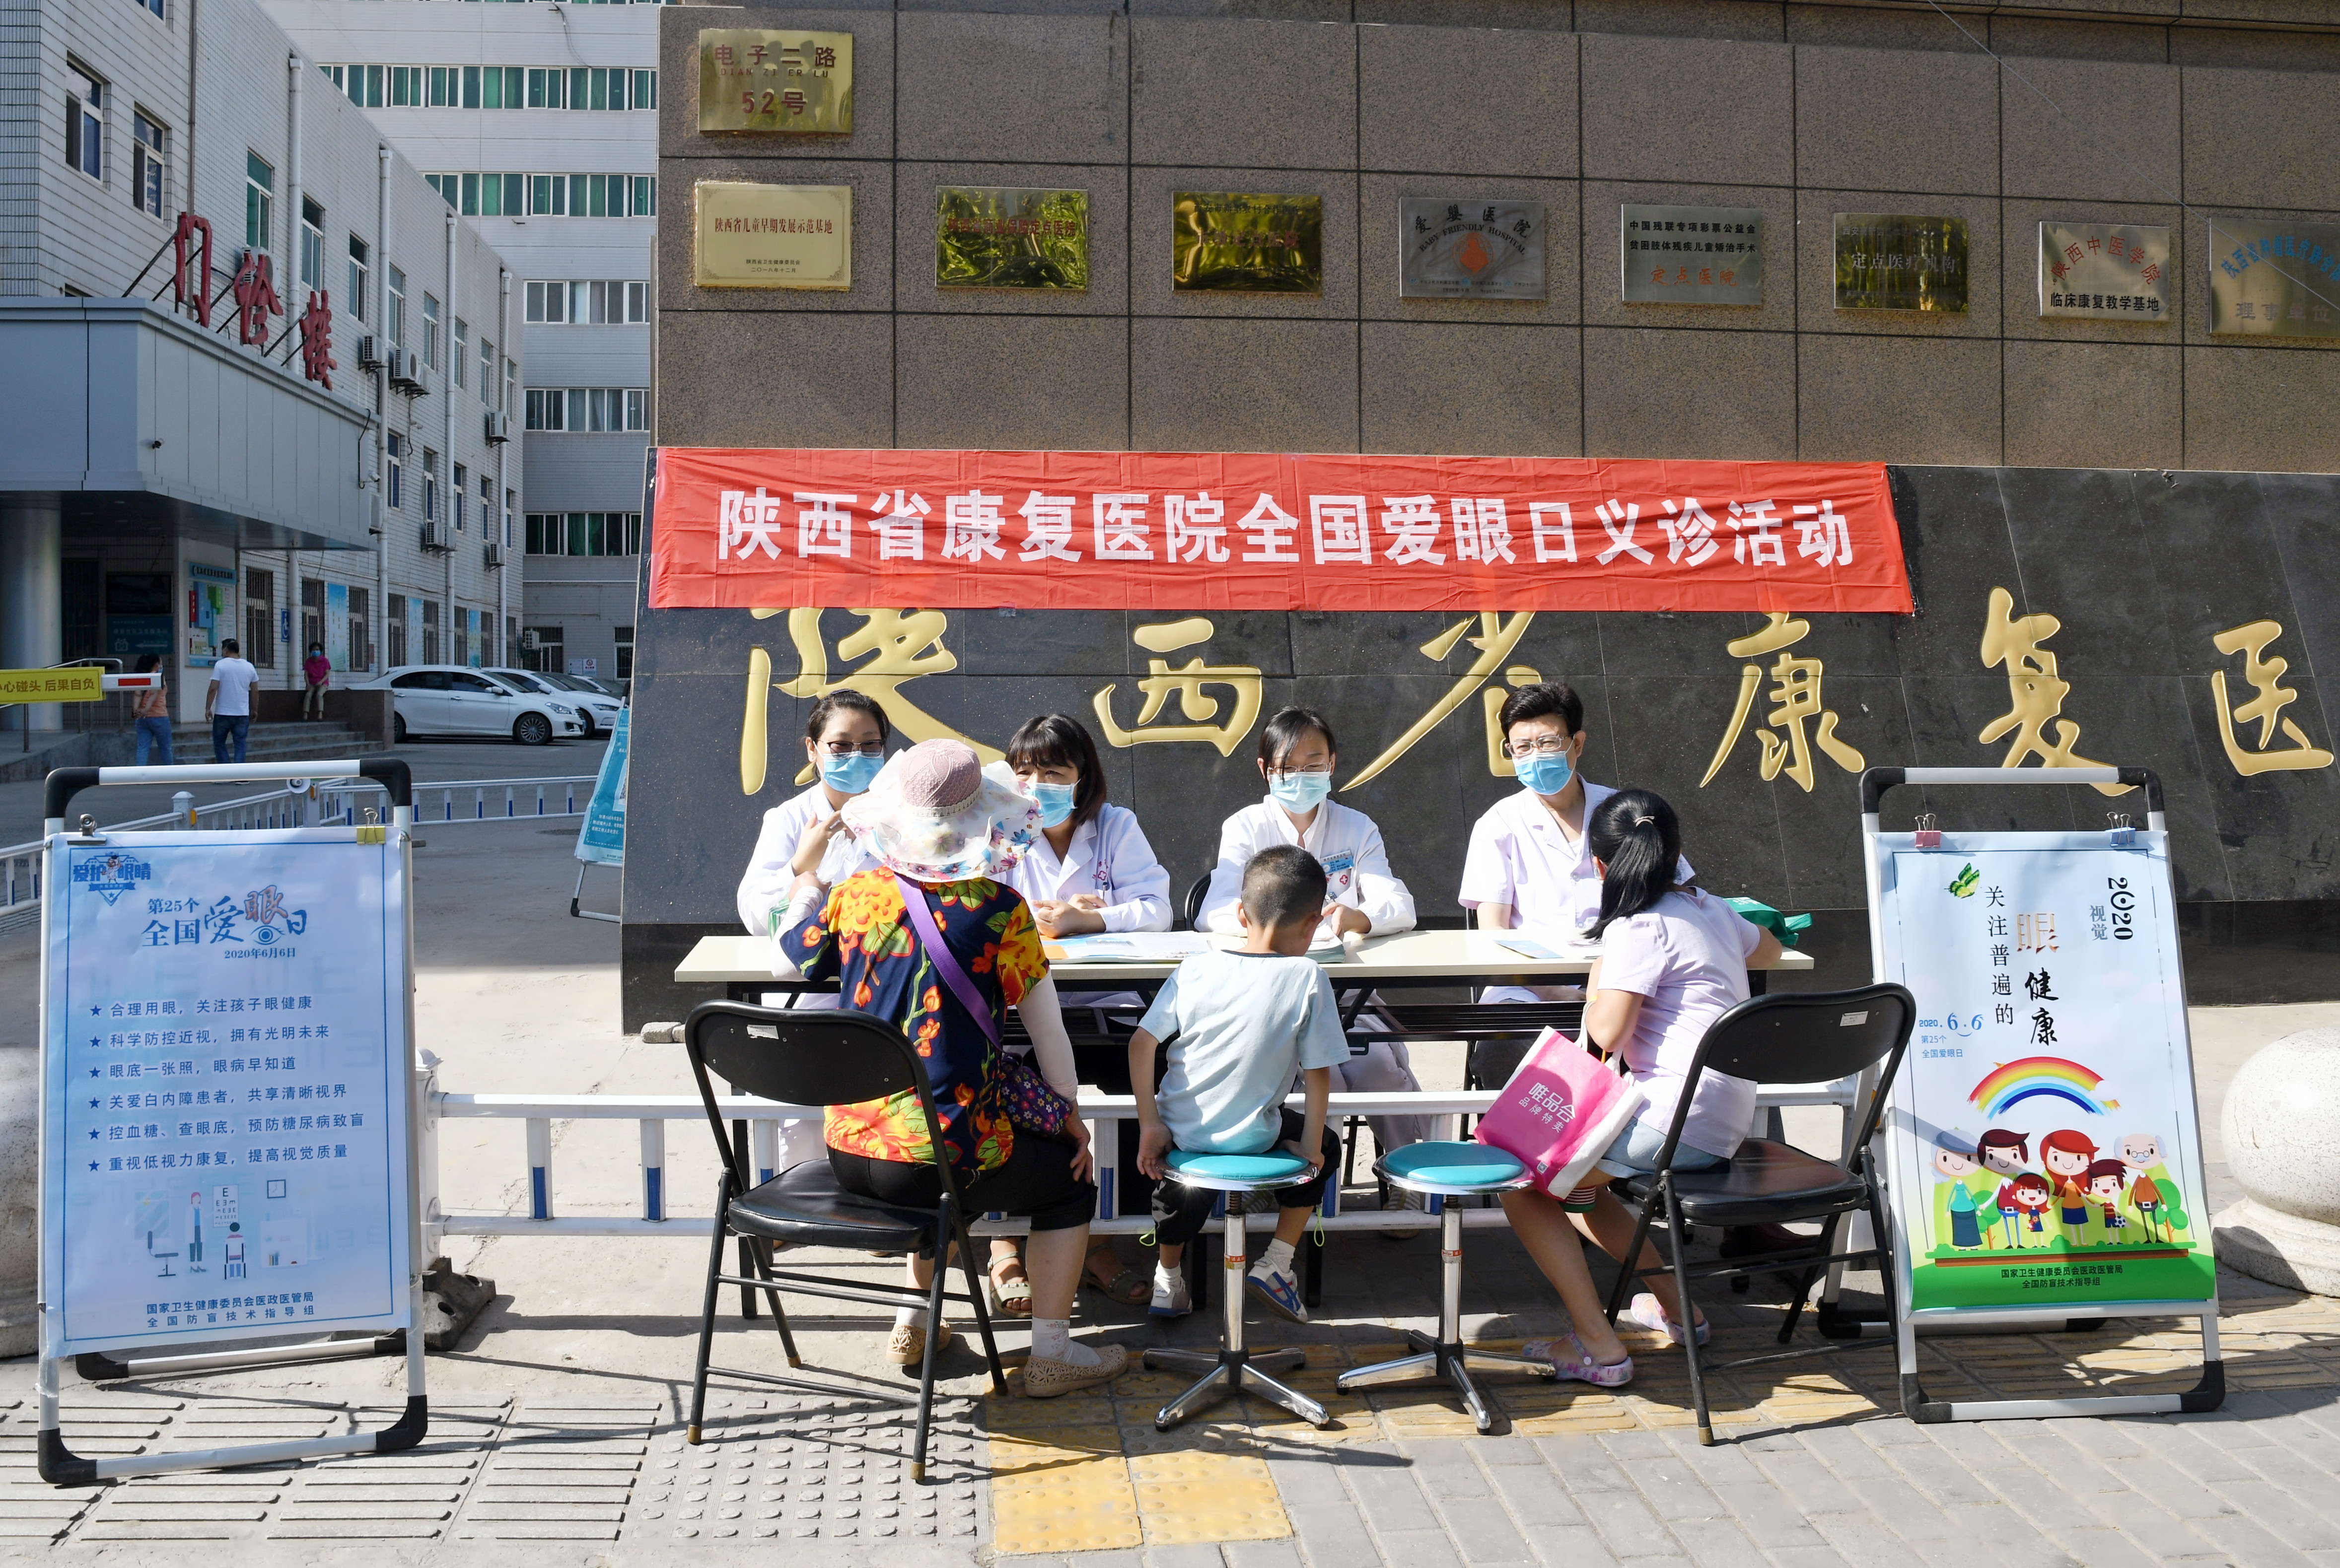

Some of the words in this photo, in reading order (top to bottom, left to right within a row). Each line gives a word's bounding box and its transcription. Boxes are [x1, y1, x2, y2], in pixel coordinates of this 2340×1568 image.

[714, 44, 837, 68] 电子二路
[742, 91, 807, 115] 52号
[714, 217, 833, 234] 陕西省儿童早期发展示范基地
[1415, 204, 1531, 238] 爱婴医院
[1630, 220, 1756, 234] 中国残联专项彩票公益金
[1419, 232, 1440, 252] BABY
[1442, 223, 1485, 236] FRIENDLY
[1489, 224, 1526, 255] HOSPITAL
[1630, 240, 1756, 253] 贫困肢体残疾儿童矫治手术
[1850, 252, 1955, 273] 定点医疗机构
[2050, 235, 2160, 285] 陕西中医学院
[1649, 265, 1737, 287] 定点医院
[2051, 292, 2160, 312] 临床康复教学基地
[717, 486, 1854, 567] 陕西省康复医院全国爱眼日义诊活动
[0, 680, 41, 693] 心碰头
[45, 678, 95, 691] 后果自负
[147, 897, 200, 914] 第25个
[142, 918, 200, 948] 全国
[2089, 904, 2109, 941] 视觉
[224, 947, 296, 960] 2020年6月6日
[1985, 885, 2015, 1026] 关注普遍的
[1920, 1034, 1947, 1044] 第25个
[1921, 1048, 1964, 1059] 全国爱眼日
[1528, 1082, 1576, 1123] 唯品会
[1518, 1096, 1564, 1133] 品牌特卖
[2000, 1264, 2124, 1279] 国家卫生健康委员会医政医管局
[2022, 1276, 2101, 1290] 全国防盲技术指导组
[146, 1291, 314, 1314] 国家卫生健康委员会医政医管局
[147, 1305, 315, 1328] 全国防盲技术指导组
